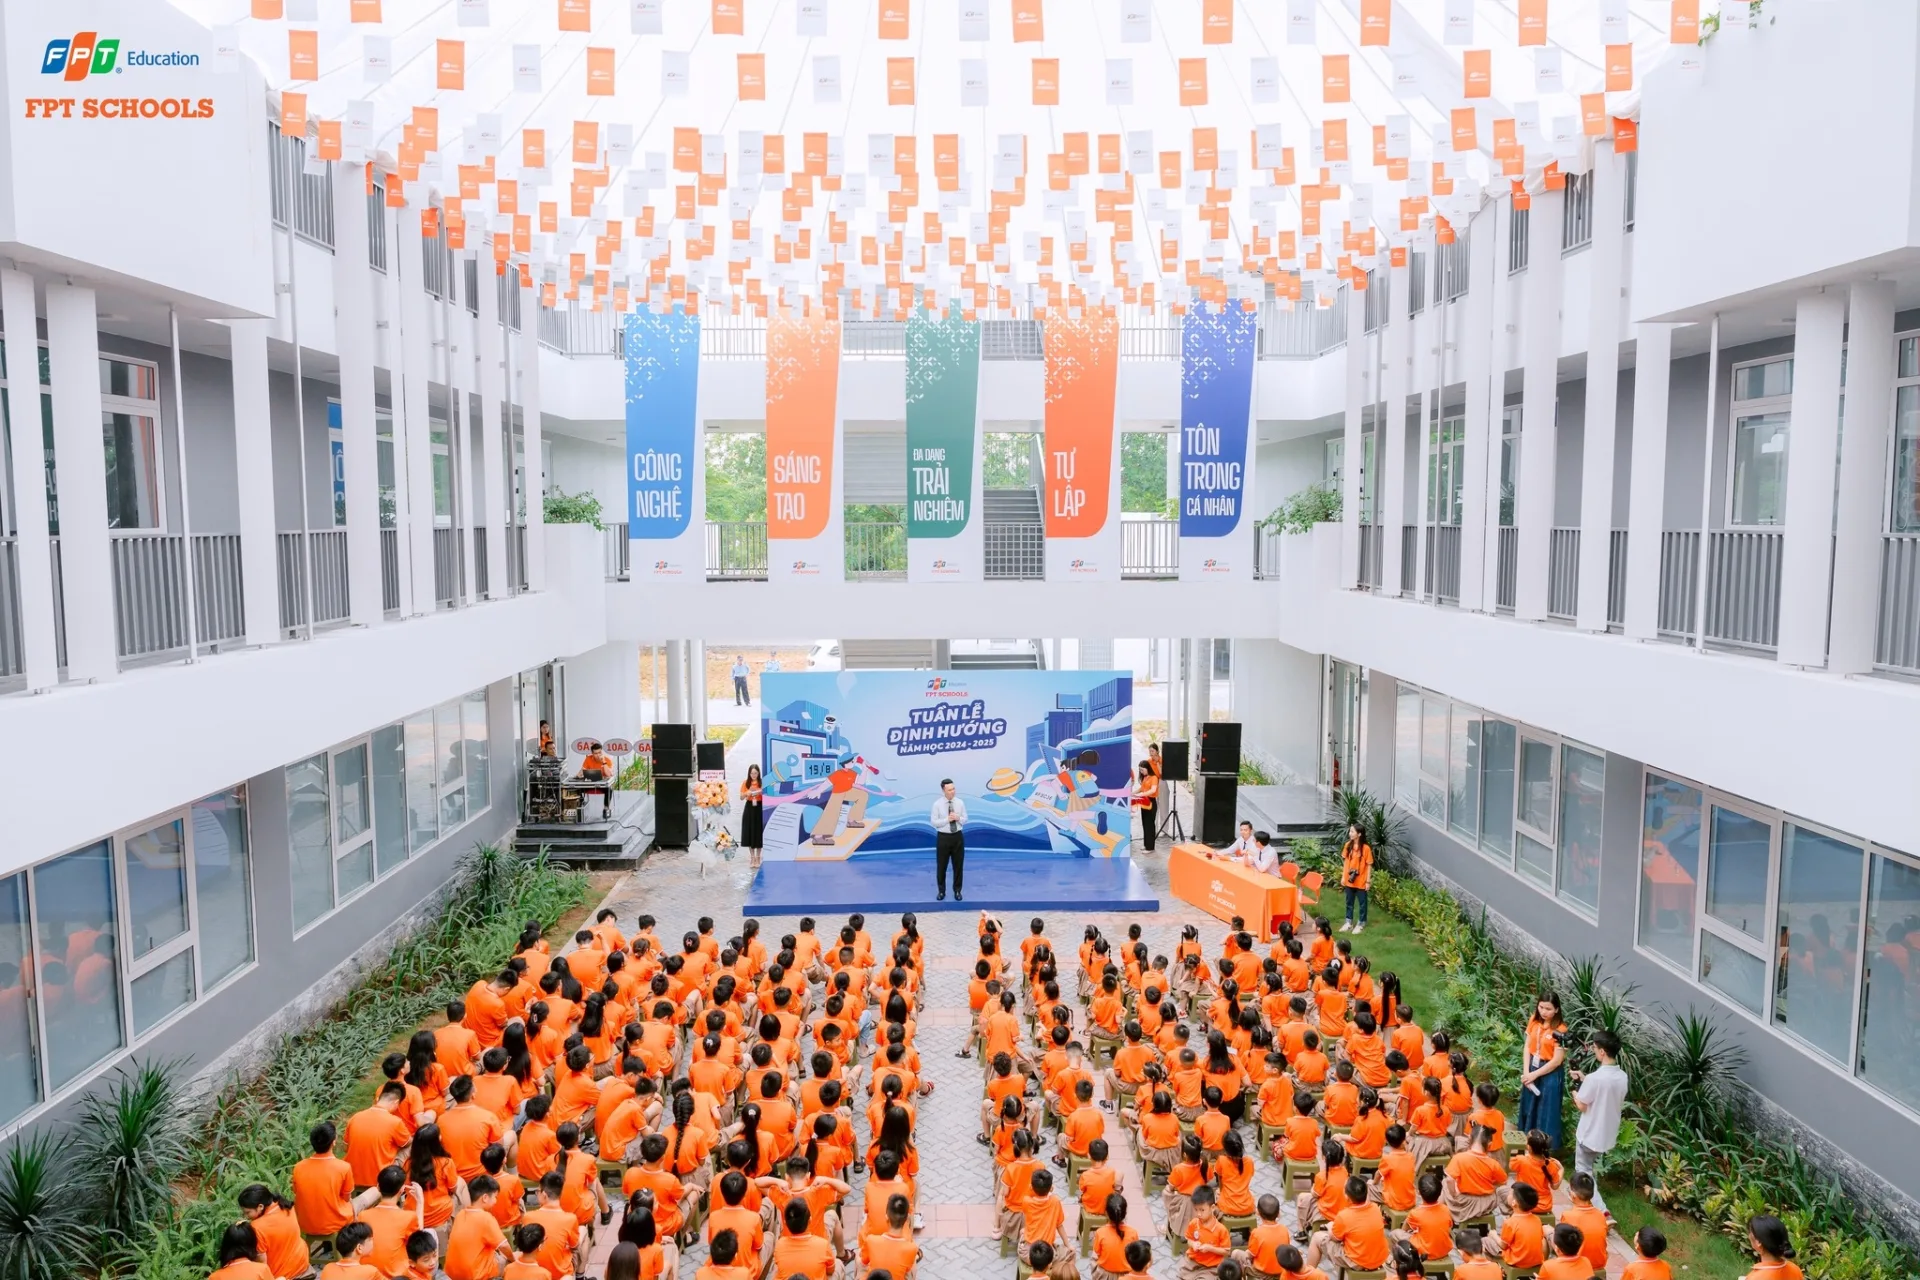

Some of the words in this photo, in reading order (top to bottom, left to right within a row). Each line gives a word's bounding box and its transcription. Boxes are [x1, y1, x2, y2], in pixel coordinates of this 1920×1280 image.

[913, 448, 924, 461] ĐA
[925, 448, 946, 462] DẠNG
[1184, 423, 1220, 456] TÔN
[634, 448, 682, 481] CÔNG
[774, 450, 821, 484] SÁNG
[913, 461, 950, 495] TRẢI
[1053, 447, 1077, 482] TỰ
[1184, 462, 1241, 493] TRỌNG
[636, 485, 682, 521] NGHỆ
[774, 492, 805, 523] TẠO
[913, 497, 964, 524] NGHIỆM
[1054, 485, 1086, 520] LẬP
[1186, 495, 1201, 516] CÁ
[1203, 495, 1235, 516] NHÂN
[912, 704, 959, 724] TUẦN
[961, 702, 982, 720] LỄ
[607, 743, 629, 752] 10A1
[889, 727, 934, 745] ĐỊNH
[937, 721, 1004, 739] HƯỚNG
[900, 742, 922, 753] NĂM
[923, 742, 945, 753] HỌC
[945, 740, 967, 749] 2024
[972, 738, 995, 748] 2025
